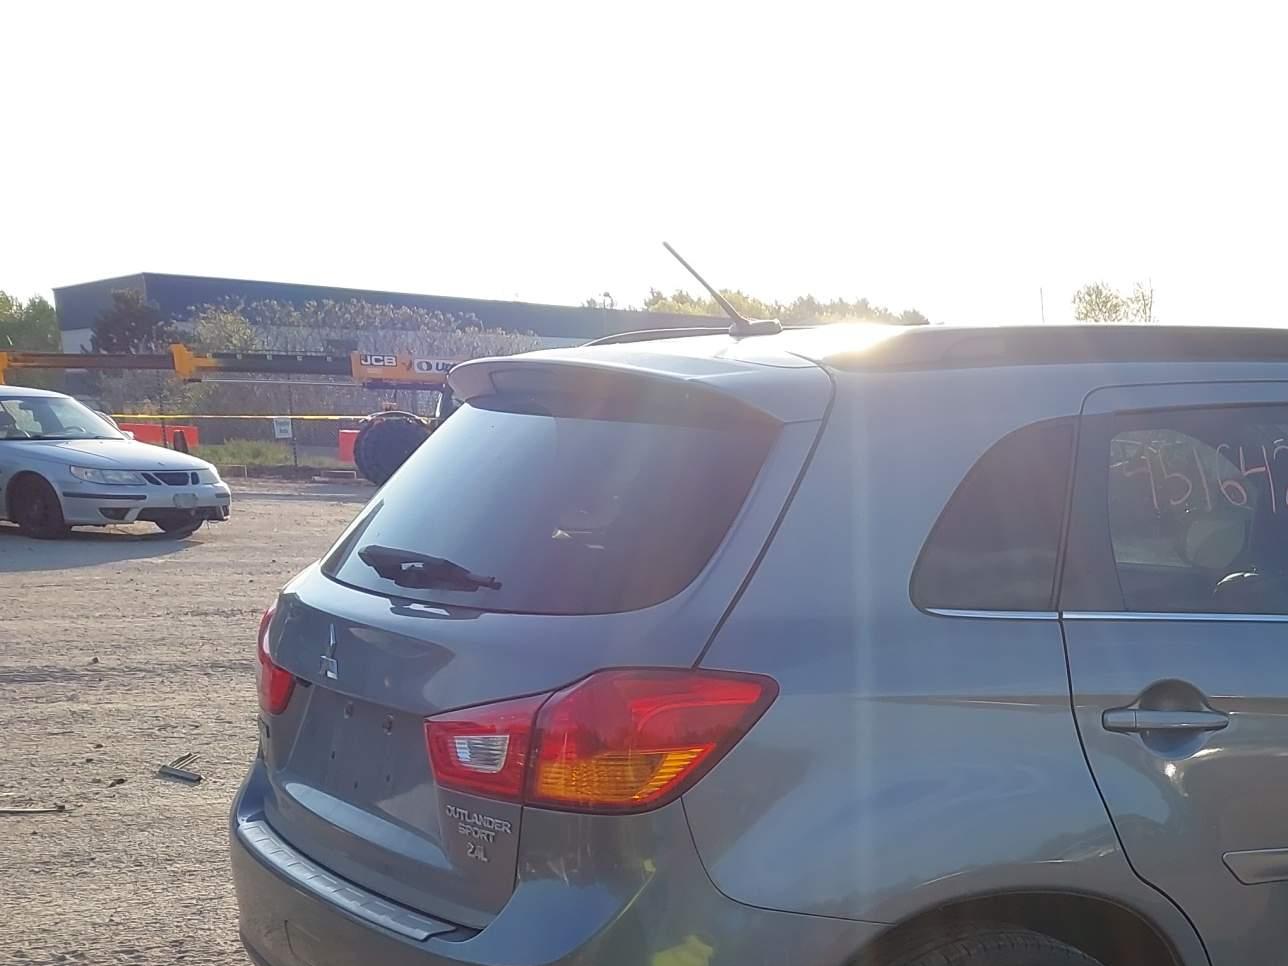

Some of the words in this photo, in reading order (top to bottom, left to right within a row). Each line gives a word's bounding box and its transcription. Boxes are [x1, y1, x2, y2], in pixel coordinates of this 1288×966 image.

[361, 355, 396, 366] JCB
[446, 805, 511, 833] OUTLANDER
[459, 823, 495, 842] SPORT
